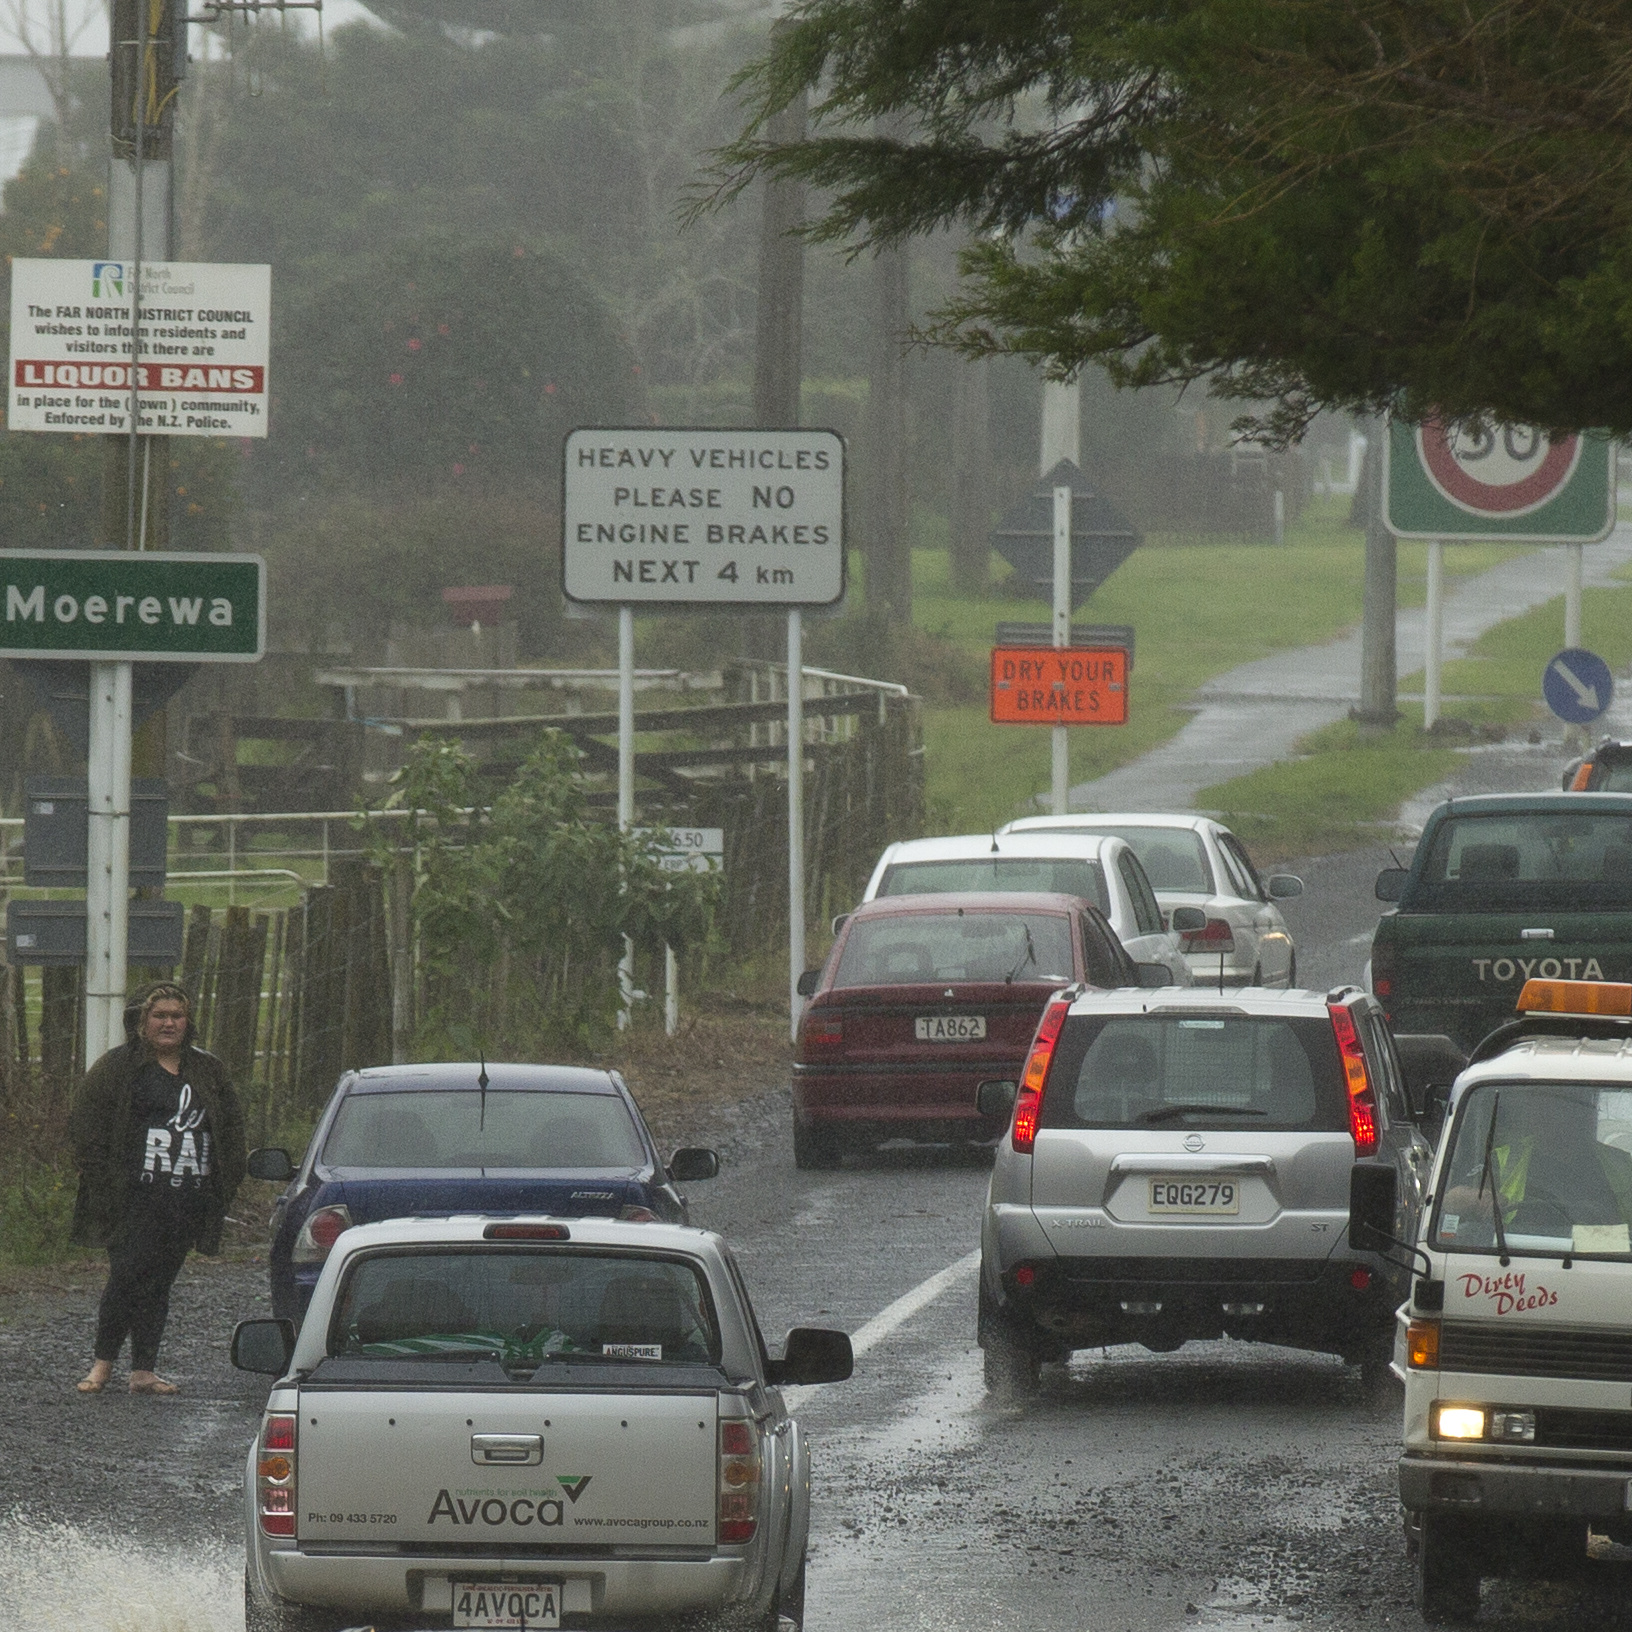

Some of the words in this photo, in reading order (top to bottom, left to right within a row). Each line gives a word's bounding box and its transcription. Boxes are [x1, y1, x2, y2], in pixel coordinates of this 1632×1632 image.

[163, 281, 195, 295] Council
[28, 304, 52, 317] The
[56, 306, 81, 318] FAR
[86, 307, 129, 320] NORTH
[198, 310, 254, 323] COUNCIL
[35, 323, 83, 336] wishes
[88, 324, 100, 336] to
[153, 326, 217, 339] residents
[221, 327, 246, 340] and
[66, 341, 117, 354] visitors
[153, 344, 188, 355] there
[192, 346, 215, 356] are
[24, 364, 149, 387] LIQUOR
[160, 367, 255, 389] BANS
[17, 394, 30, 406] in
[34, 394, 71, 409] place
[75, 395, 95, 407] for
[99, 397, 120, 408] the
[181, 400, 260, 415] community,
[45, 412, 106, 425] Enforced
[109, 412, 125, 428] by
[157, 415, 182, 428] N.Z.
[187, 416, 232, 429] Police.
[578, 448, 676, 468] HEAVY
[689, 449, 830, 470] VEHICLES
[614, 487, 722, 508] PLEASE
[752, 485, 796, 509] NO
[576, 523, 690, 544] ENGINE
[706, 524, 830, 545] BRAKES
[613, 560, 700, 583] NEXT
[717, 560, 740, 583] 4
[756, 565, 795, 584] km
[6, 584, 233, 627] Moerewa
[1003, 659, 1045, 681] DRY
[1057, 659, 1116, 682] YOUR
[1016, 689, 1101, 712] BRAKES
[1472, 957, 1605, 981] TOYOTA
[922, 1018, 981, 1039] TA862
[1151, 1183, 1235, 1206] EQG279
[1311, 1223, 1330, 1233] ST
[1456, 1272, 1526, 1299] Dirty
[1487, 1286, 1560, 1316] Deeds
[307, 1512, 327, 1523] Ph:
[329, 1513, 344, 1523] 09
[346, 1513, 367, 1524] 433
[369, 1513, 398, 1524] 5720
[427, 1489, 565, 1527] Avoca
[573, 1517, 709, 1529] www.avocagroup.co.nz
[457, 1592, 557, 1618] 4AVOCA
